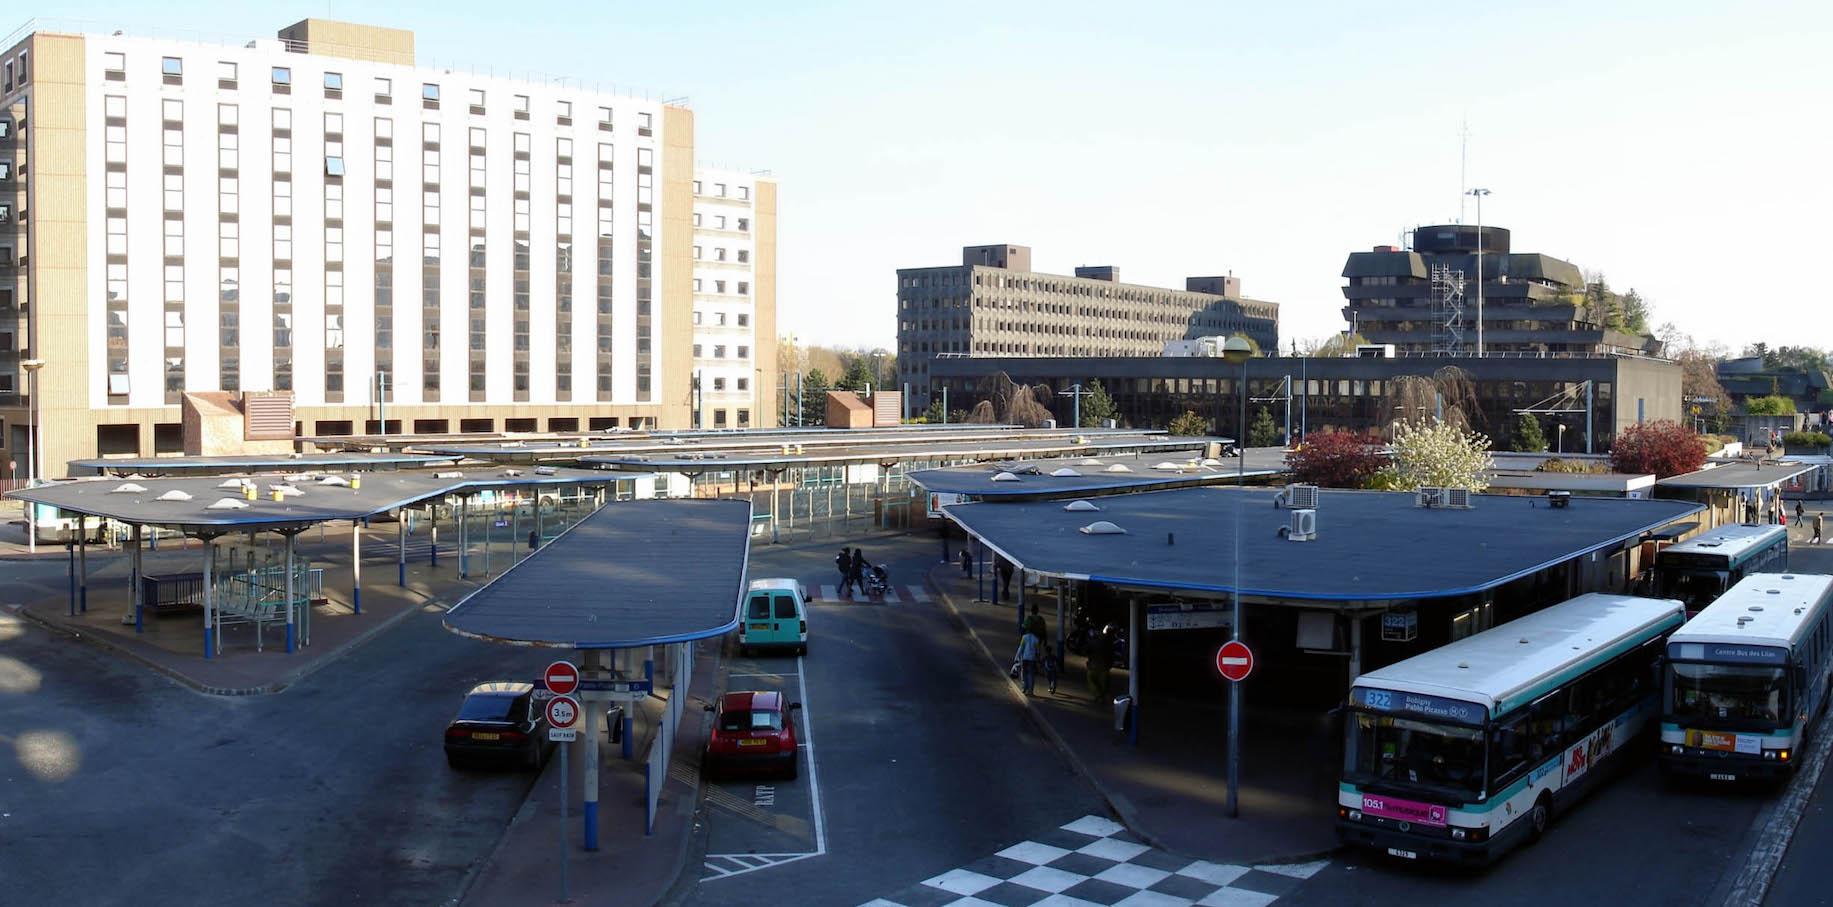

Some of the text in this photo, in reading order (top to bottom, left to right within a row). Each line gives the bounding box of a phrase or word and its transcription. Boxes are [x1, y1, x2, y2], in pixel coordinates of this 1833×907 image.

[1384, 616, 1405, 627] 322
[1715, 648, 1735, 656] Centre
[1368, 691, 1391, 708] 322
[1406, 695, 1431, 706] Bobigny
[1405, 703, 1424, 712] Pablo
[1424, 705, 1448, 715] Picasso
[754, 785, 775, 806] RATP
